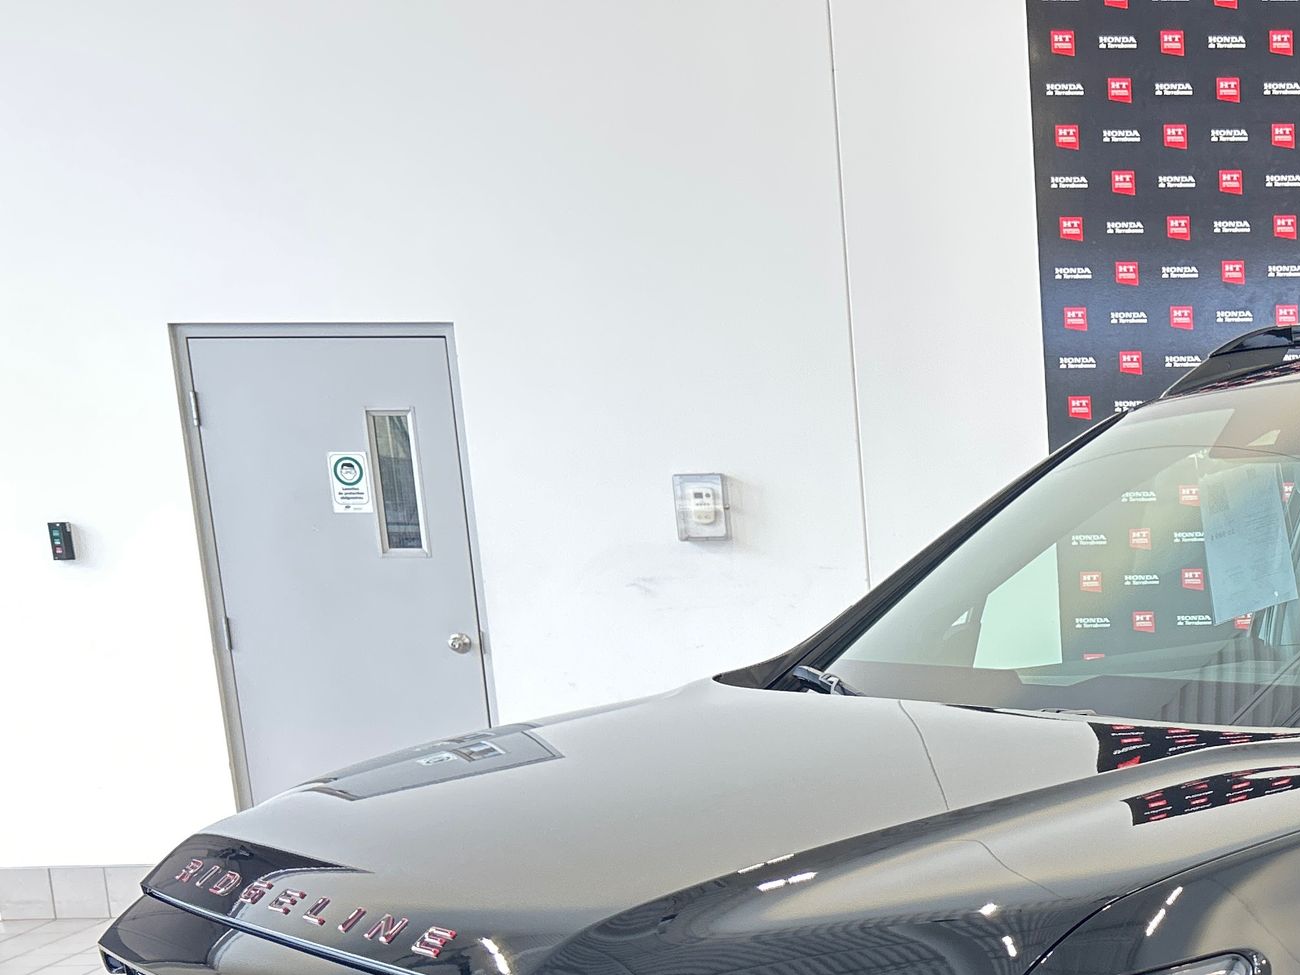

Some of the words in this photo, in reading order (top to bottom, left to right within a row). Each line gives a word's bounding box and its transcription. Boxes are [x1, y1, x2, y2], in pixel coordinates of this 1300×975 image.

[1099, 36, 1137, 44] HONDA
[1046, 83, 1084, 91] HONDA
[1264, 82, 1300, 90] HONDA
[1211, 129, 1248, 137] HONDA
[1051, 176, 1088, 184] HONDA
[175, 858, 458, 959] RIDGELINE
